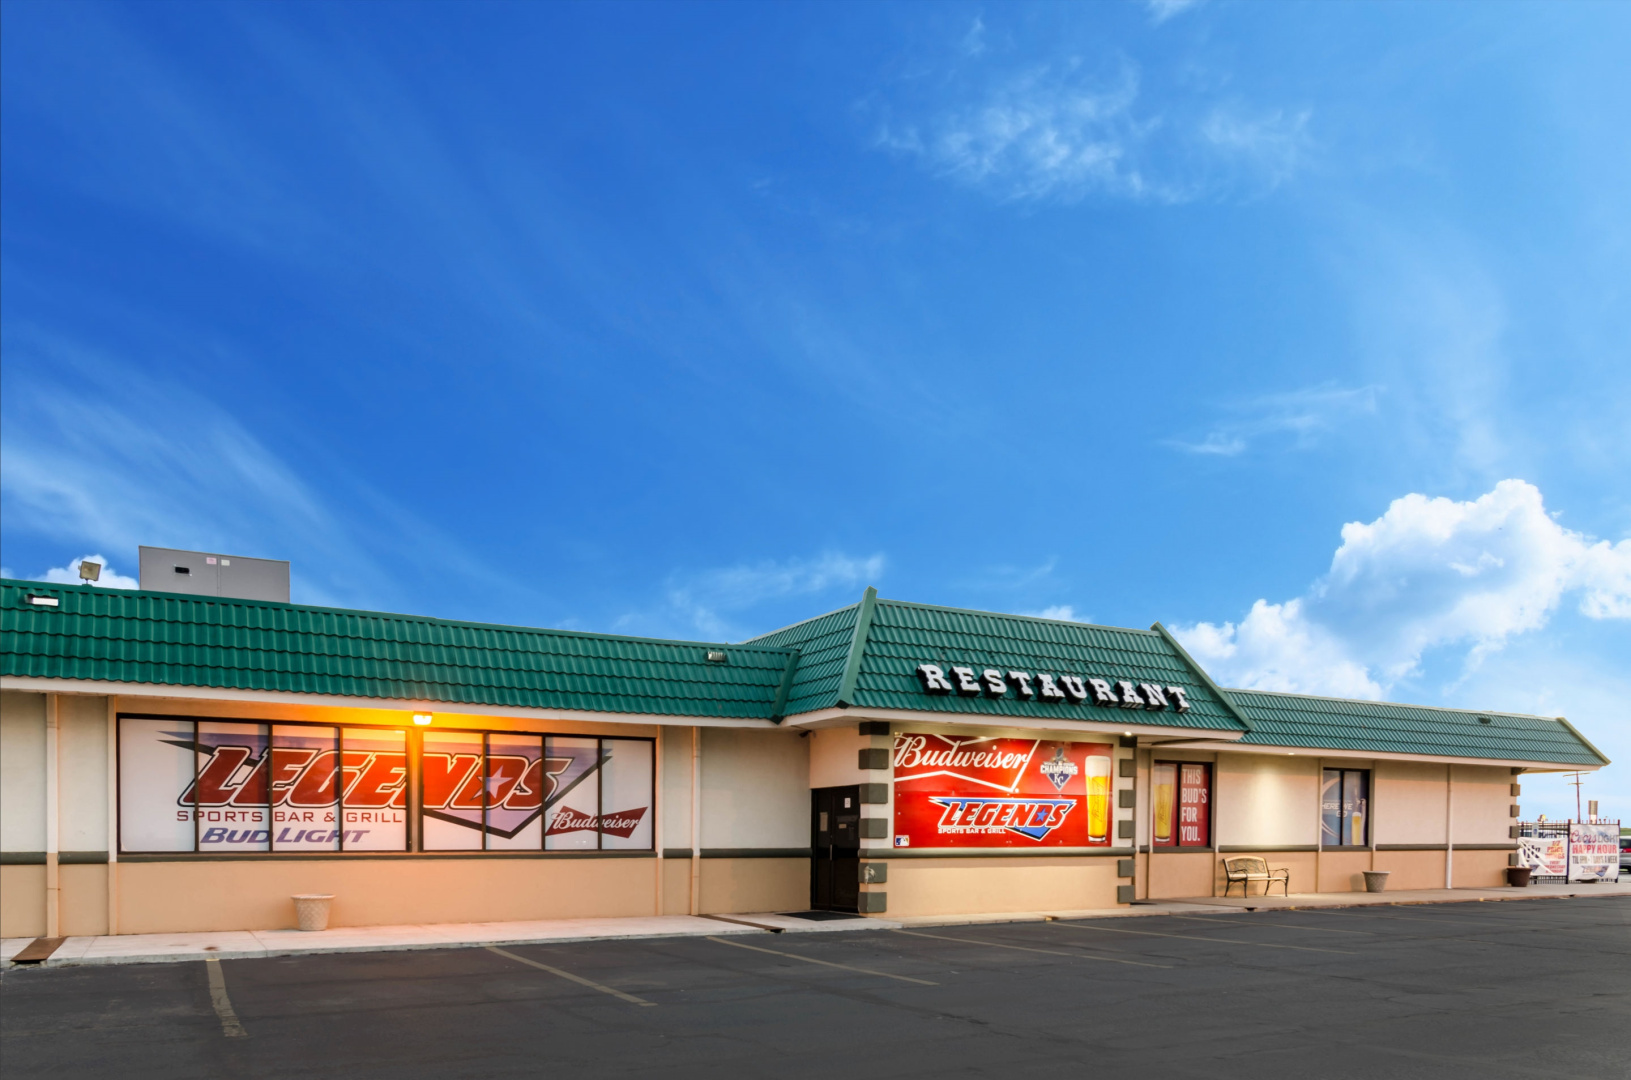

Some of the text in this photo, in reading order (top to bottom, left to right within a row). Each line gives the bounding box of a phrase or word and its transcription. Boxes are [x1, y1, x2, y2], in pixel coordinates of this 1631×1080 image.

[917, 663, 1191, 711] RESTAURANT
[894, 733, 1028, 769] Budweiser
[1040, 764, 1078, 775] CHAMPIONS
[1182, 768, 1201, 784] THIS
[177, 745, 575, 811] LEGENDS
[1181, 788, 1207, 803] BUD'S
[176, 810, 403, 823] SPORTS BAR & GRILL
[938, 801, 1070, 829] LEGENDS
[1181, 807, 1198, 822] FOR
[1181, 826, 1201, 841] YOU.
[1572, 844, 1617, 854] HAPPY HOUR
